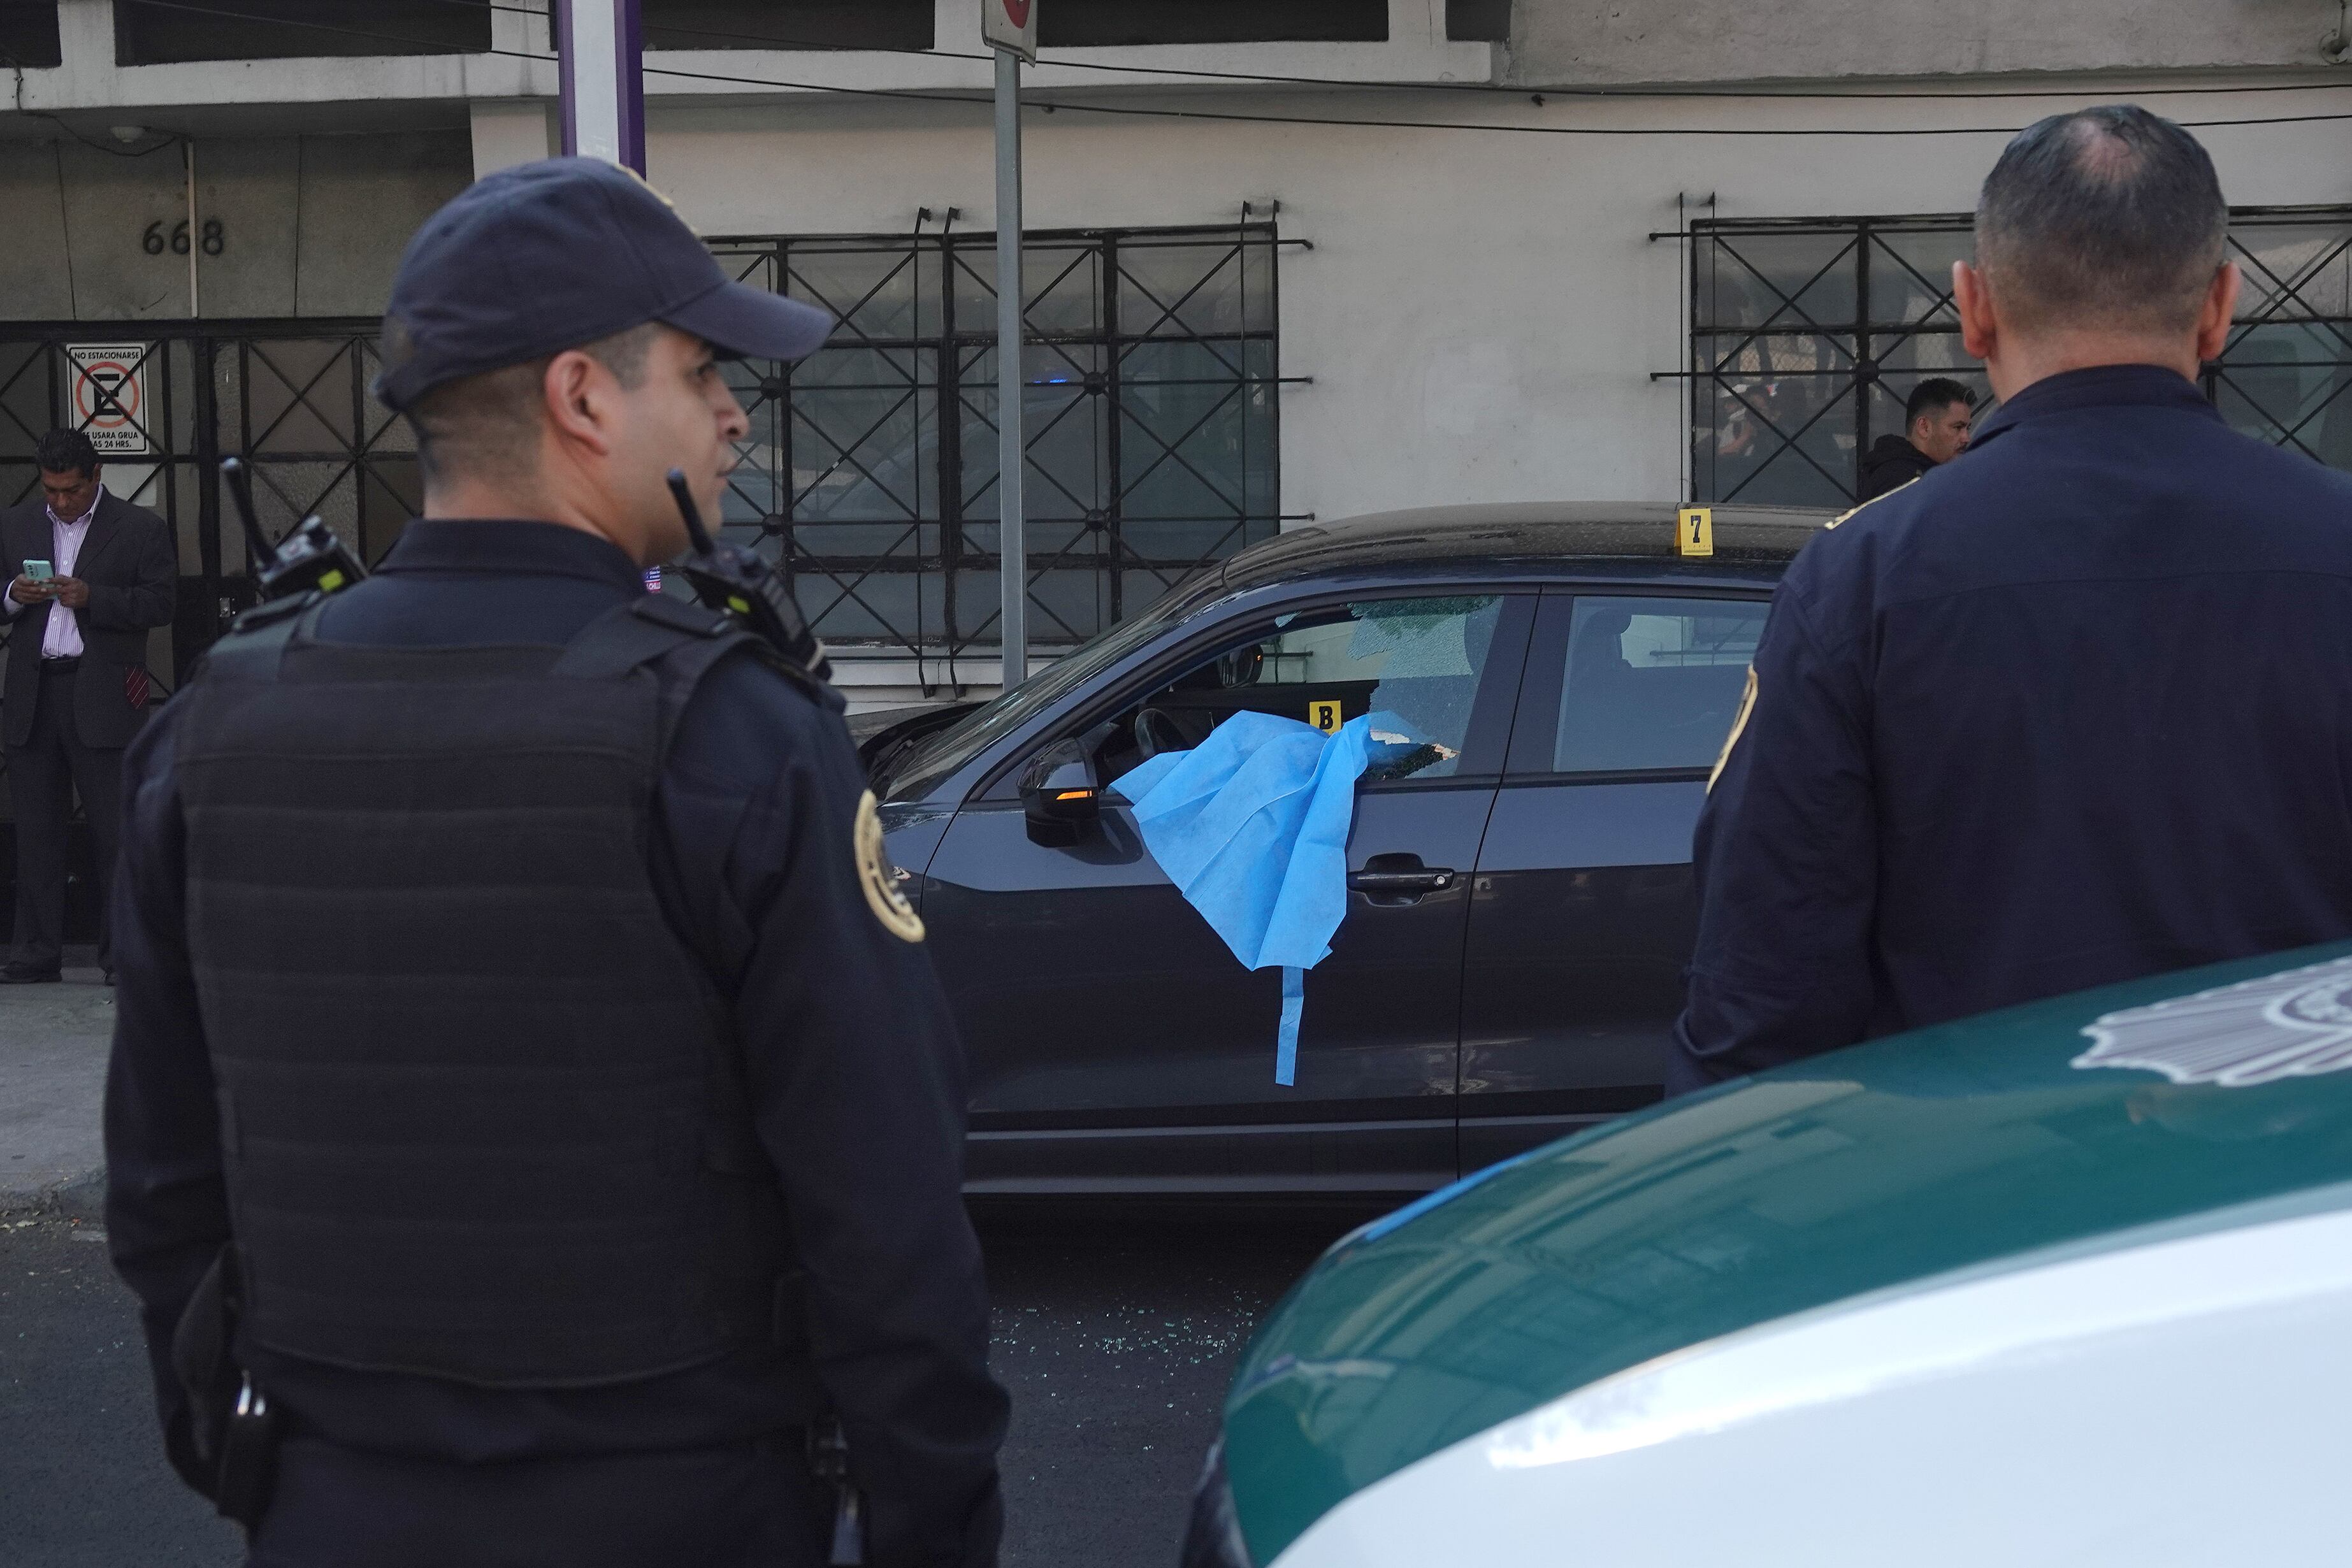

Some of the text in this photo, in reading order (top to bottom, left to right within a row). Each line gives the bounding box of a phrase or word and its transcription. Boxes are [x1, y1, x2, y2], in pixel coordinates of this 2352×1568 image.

[143, 220, 224, 255] 668
[1691, 515, 1701, 543] 7
[1319, 705, 1334, 730] B
